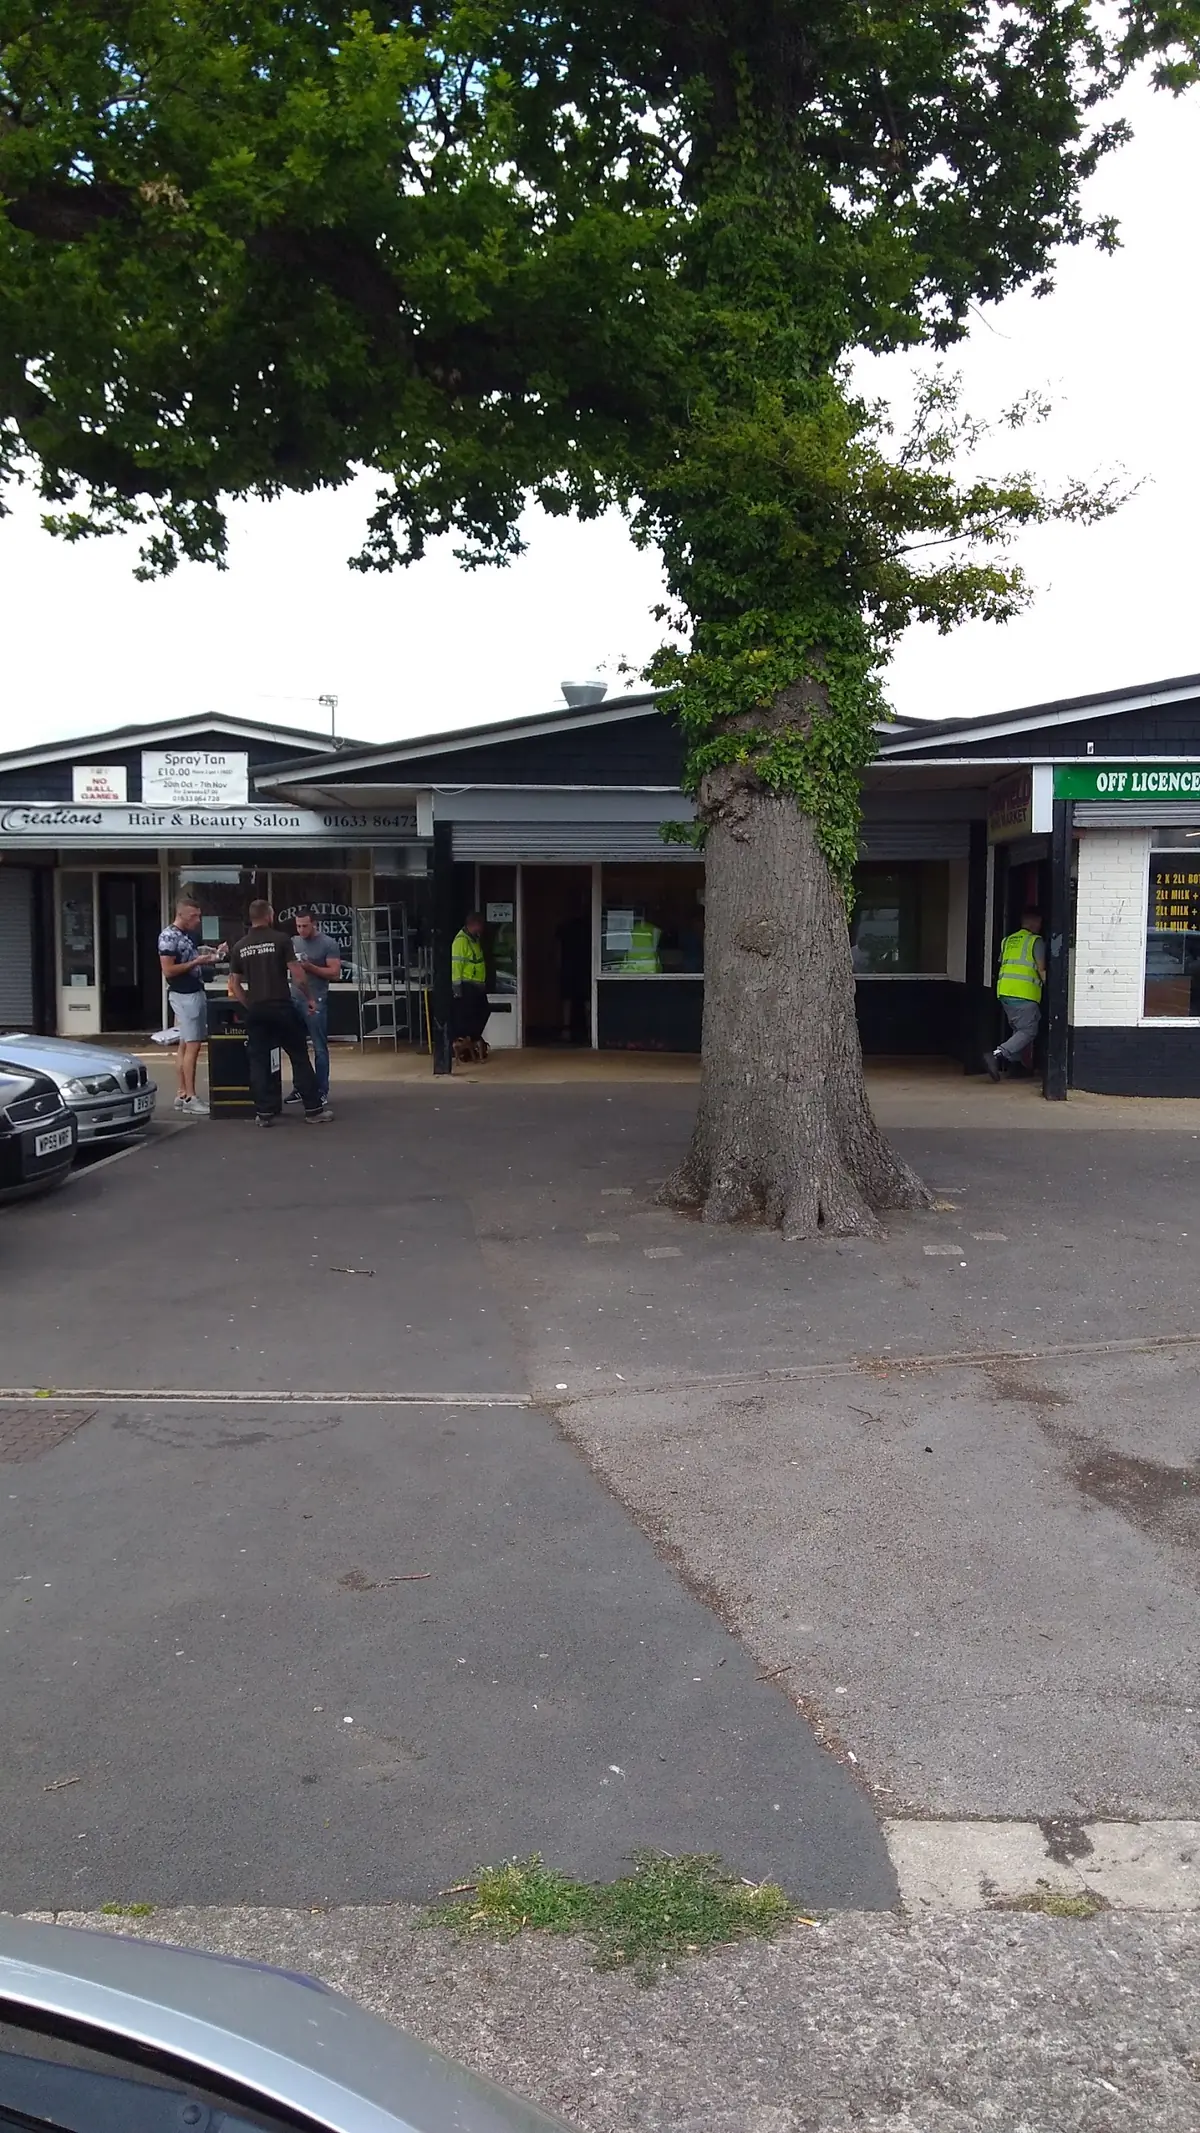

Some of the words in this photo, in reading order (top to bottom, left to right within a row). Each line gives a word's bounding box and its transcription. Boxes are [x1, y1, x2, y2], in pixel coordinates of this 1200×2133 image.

[165, 753, 201, 766] Spray
[203, 753, 226, 765] Tan
[158, 768, 190, 776] £10.00
[92, 777, 107, 785] NO
[1096, 772, 1128, 792] OFF
[1131, 772, 1200, 792] LICENCE
[1, 807, 103, 831] Creations
[129, 813, 166, 825] Hair
[171, 813, 183, 825] &
[190, 813, 248, 830] Beauty
[253, 814, 300, 827] Salon
[323, 815, 367, 827] 01633
[1156, 873, 1162, 884] 2
[1171, 889, 1190, 900] MILK
[1170, 905, 1189, 916] MILK
[1170, 921, 1189, 932] MILK
[224, 1027, 246, 1035] Litter
